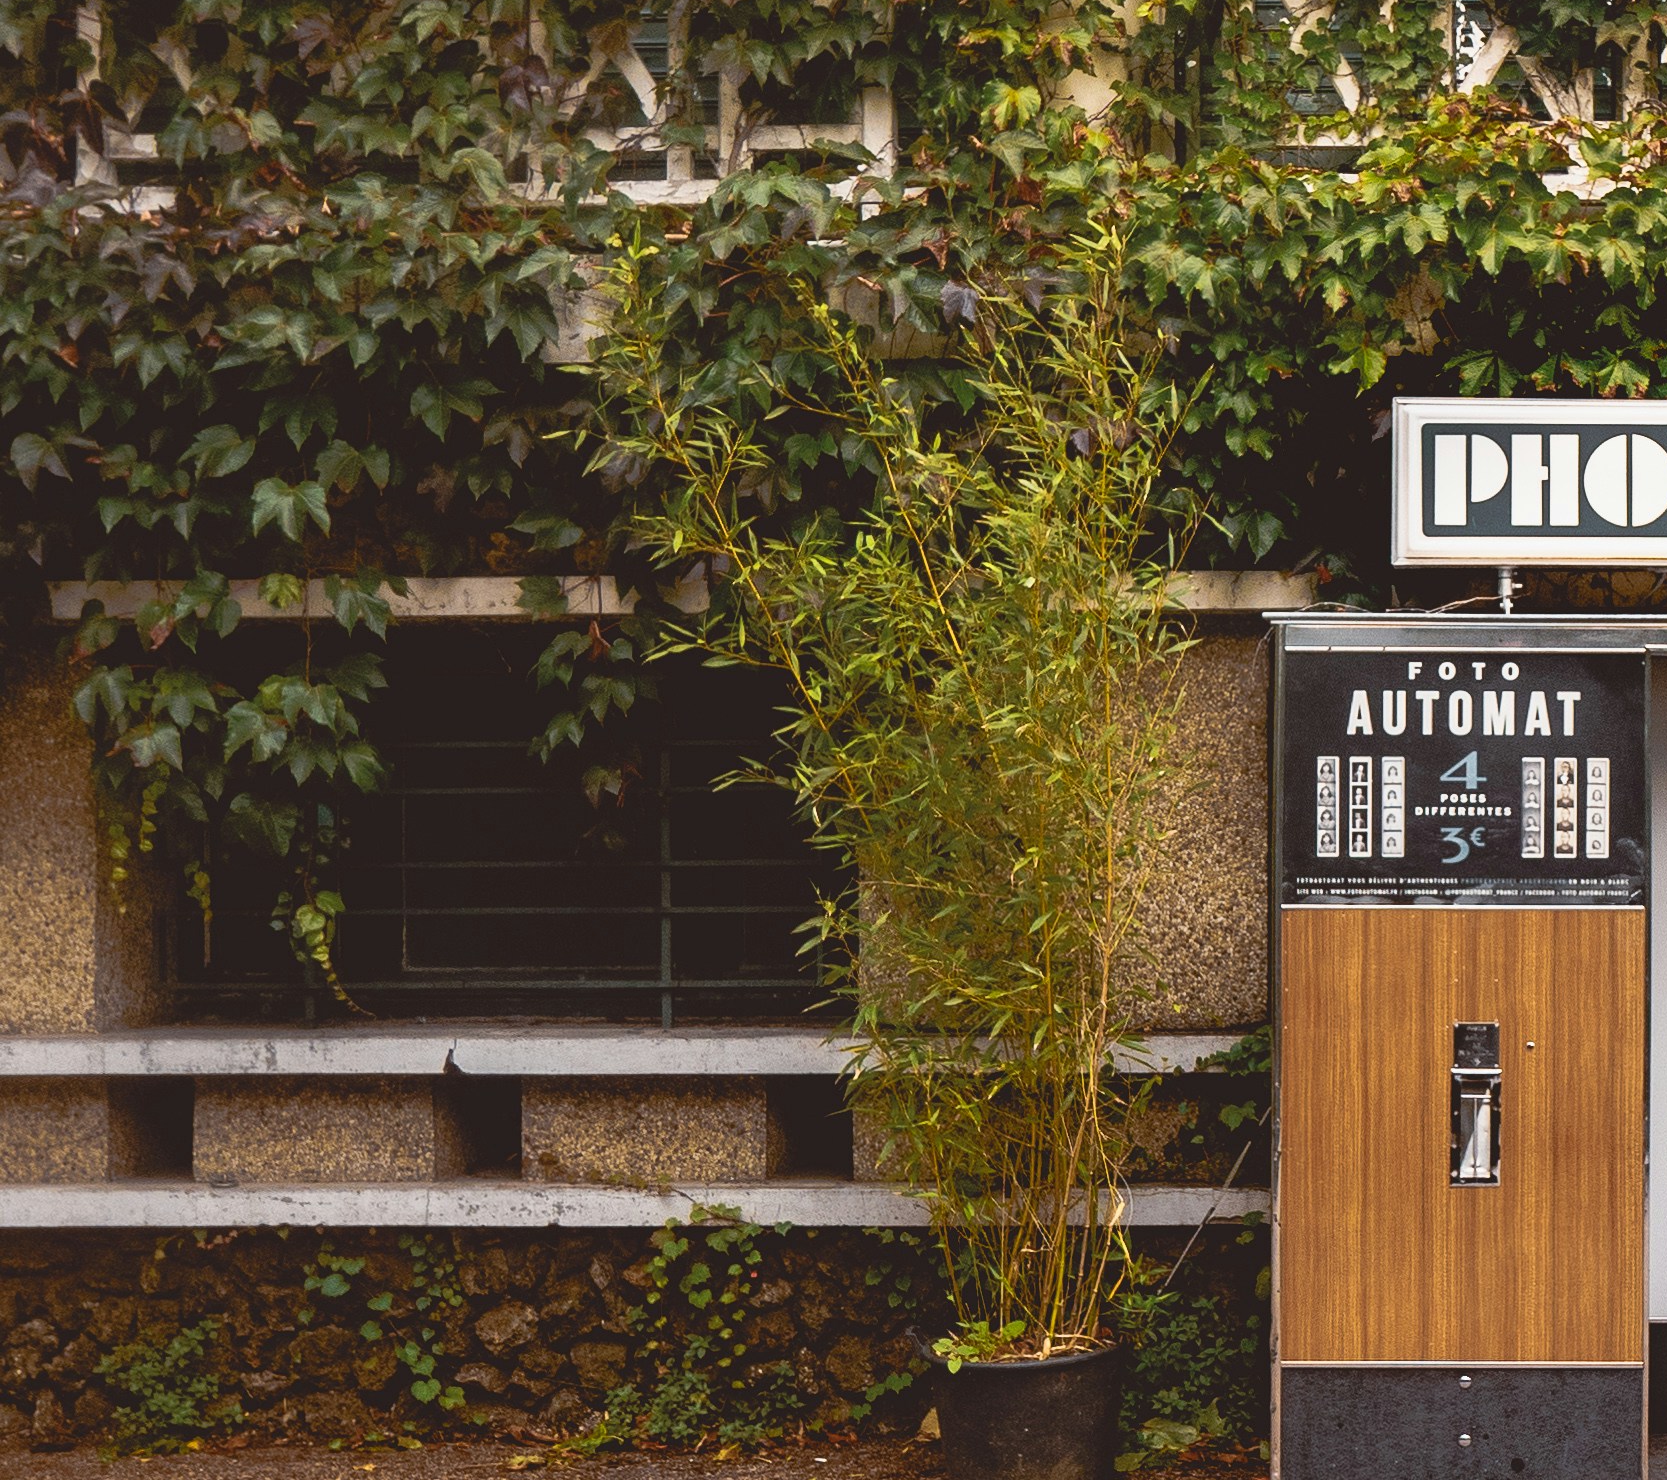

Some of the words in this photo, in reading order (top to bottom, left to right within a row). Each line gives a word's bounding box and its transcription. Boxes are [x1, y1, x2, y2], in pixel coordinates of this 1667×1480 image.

[1408, 661, 1520, 681] FOTO
[1346, 690, 1581, 737] AUTOMAT
[1439, 750, 1488, 790] 4
[1415, 806, 1512, 817] DIFFERENTES
[1440, 793, 1487, 804] POSES
[1440, 826, 1486, 864] 3€
